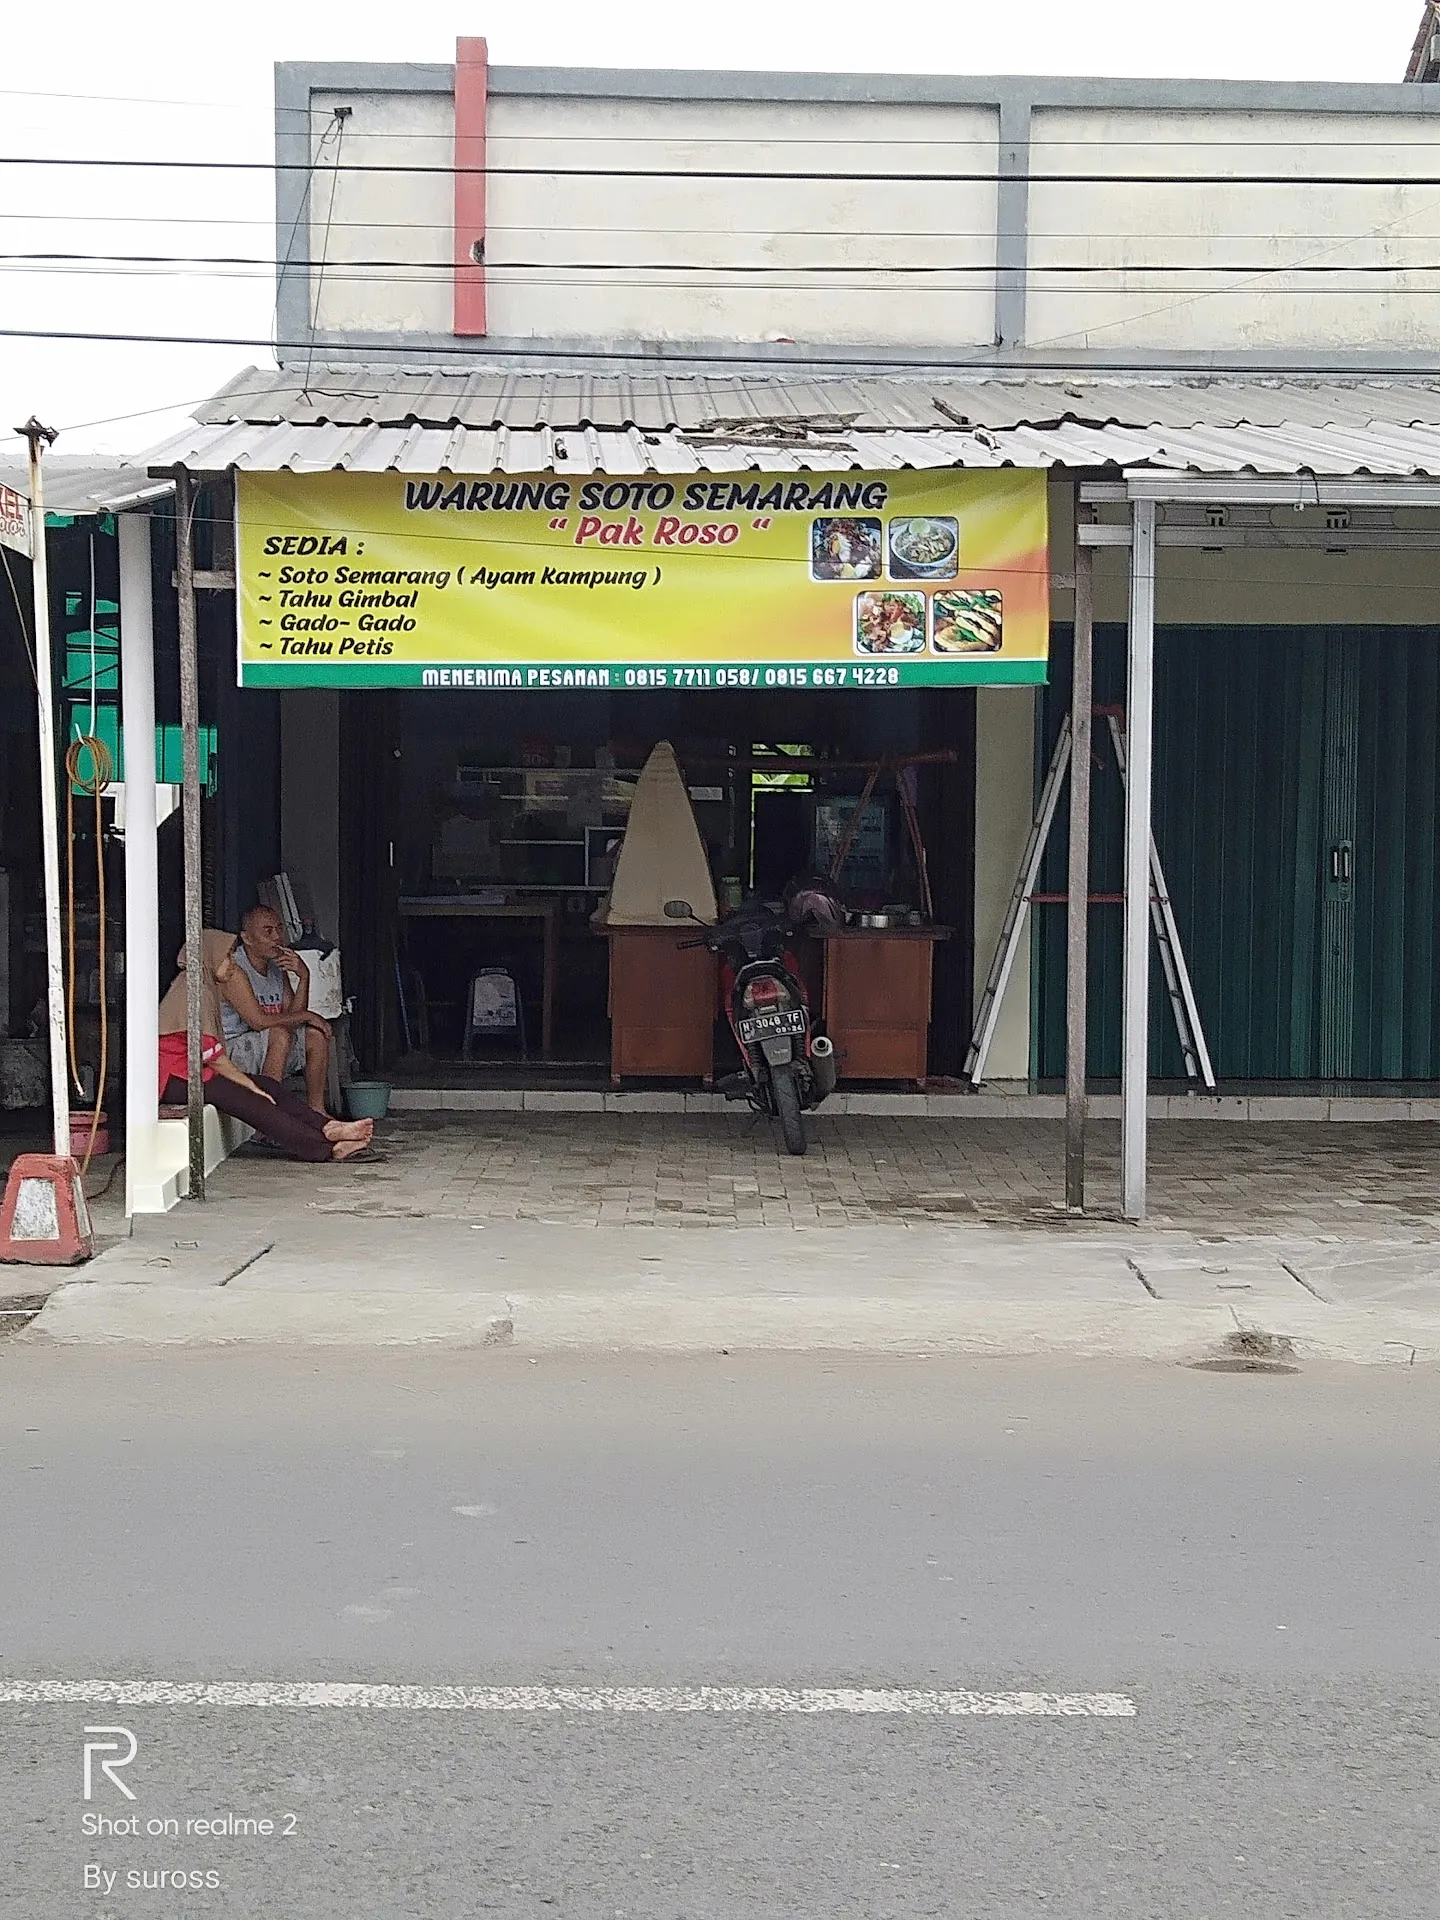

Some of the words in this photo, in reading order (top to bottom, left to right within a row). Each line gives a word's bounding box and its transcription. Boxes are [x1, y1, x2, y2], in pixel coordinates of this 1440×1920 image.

[406, 481, 571, 511] WARUNG
[579, 481, 675, 511] SOTO
[682, 481, 888, 511] SEMARANG
[574, 516, 644, 545] Pak
[653, 516, 739, 545] Roso
[263, 536, 348, 556] SEDIA
[278, 566, 329, 585] Soto
[334, 566, 451, 589] Semarang
[470, 567, 536, 589] Ayam
[541, 566, 648, 589] Kampung
[279, 590, 333, 608] Tahu
[338, 590, 419, 608] Gimbal
[358, 614, 417, 631] Gado
[280, 637, 334, 655] Tahu
[339, 637, 394, 655] Petis
[422, 668, 522, 686] MENERIMA
[527, 668, 610, 686] PESANAN
[625, 668, 667, 686] 0815
[673, 668, 710, 686] 7711
[765, 668, 807, 686] 0815
[812, 668, 847, 685] 667
[852, 667, 899, 685] 4228
